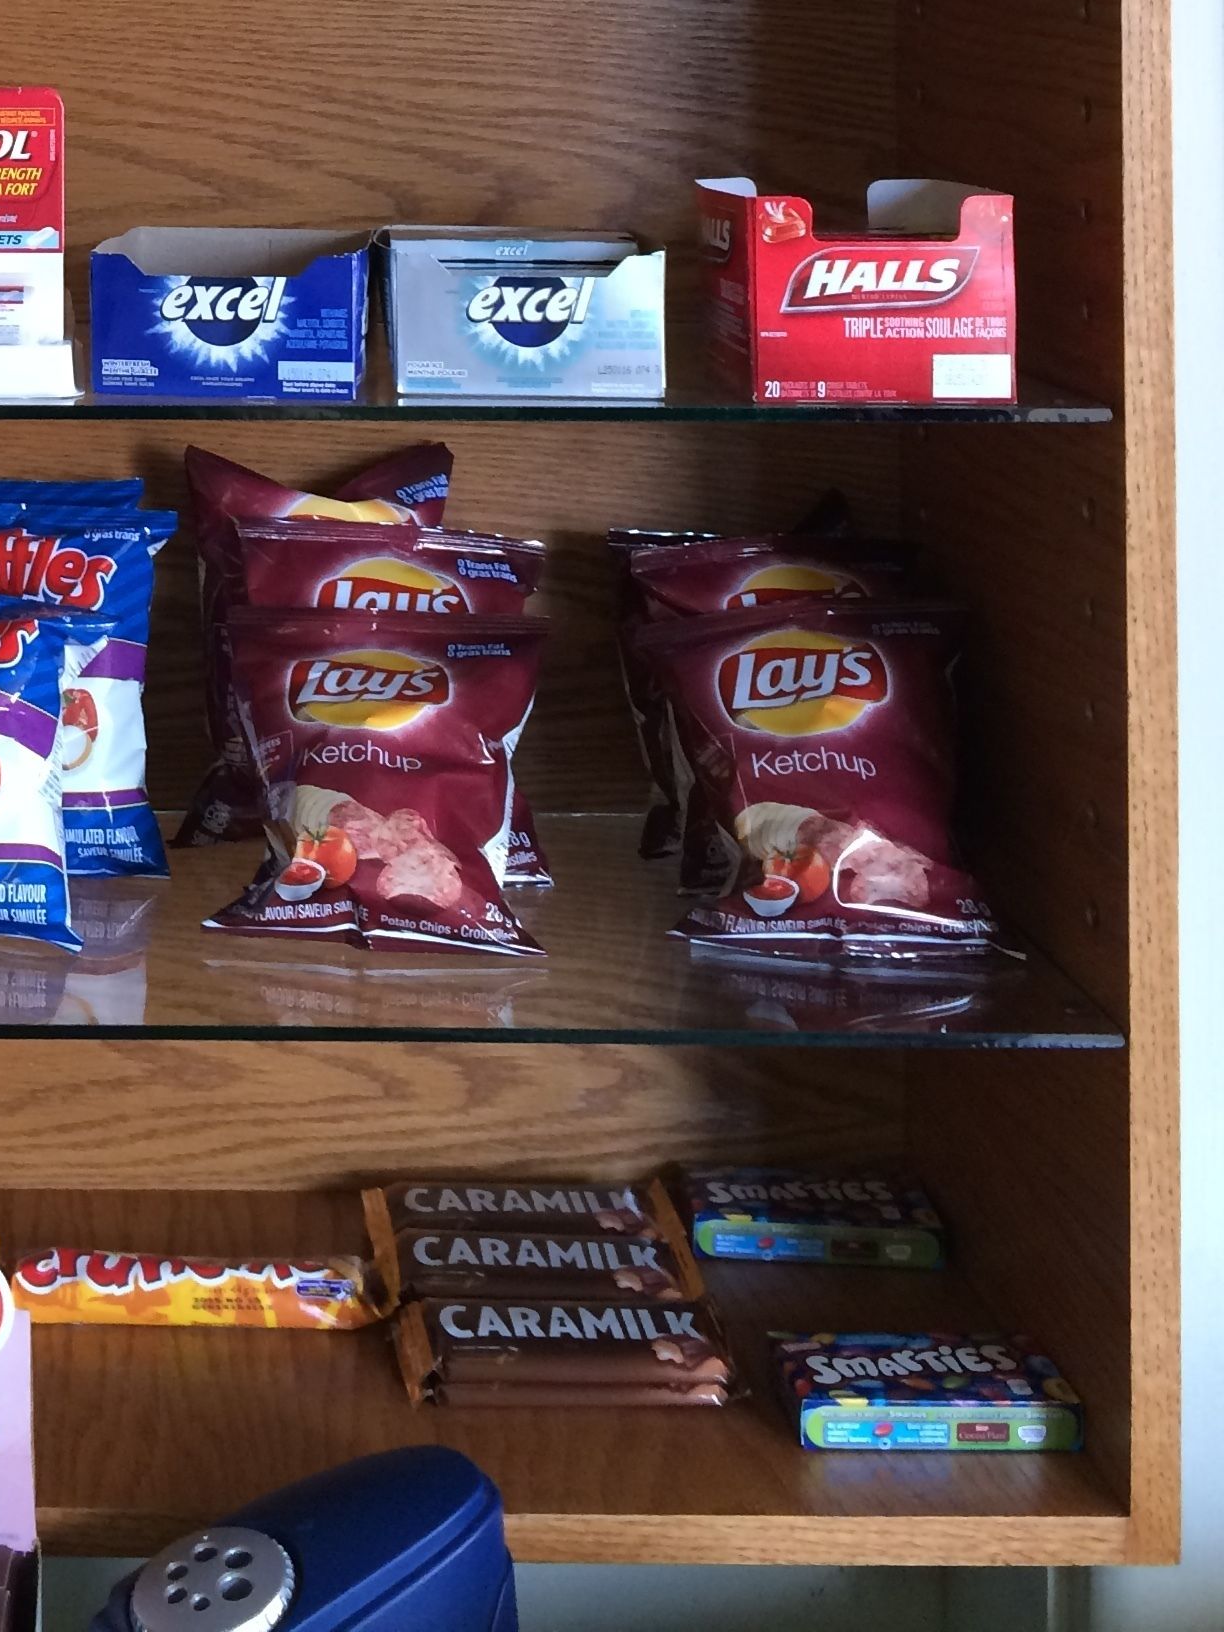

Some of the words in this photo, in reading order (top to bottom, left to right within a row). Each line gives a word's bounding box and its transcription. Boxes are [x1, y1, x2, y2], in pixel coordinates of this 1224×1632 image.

[5, 183, 38, 196] FORT
[495, 244, 528, 256] excel
[804, 258, 960, 299] HALLS
[161, 276, 286, 322] excel
[468, 277, 596, 323] excel
[843, 317, 884, 338] TRIPLE
[885, 317, 924, 327] SOOTHING
[925, 317, 974, 338] SOULAGE
[885, 328, 925, 338] ACTION
[764, 381, 780, 397] 20
[817, 381, 826, 397] 9
[457, 559, 464, 568] 0
[467, 559, 493, 570] Trans
[495, 563, 510, 572] Fat
[458, 567, 466, 575] 0
[468, 569, 490, 578] gras
[492, 571, 517, 583] trans
[296, 661, 438, 704] Lay's
[733, 645, 873, 709] Lay's
[301, 739, 422, 773] Ketchup
[751, 746, 876, 781] Ketchup
[8, 883, 46, 903] FLAVOUR
[12, 905, 47, 925] SIMULÉE
[380, 914, 417, 929] Potato
[420, 920, 451, 936] Chips
[404, 1187, 644, 1214] CARAMILK
[413, 1236, 659, 1271] CARAMILK
[439, 1304, 704, 1341] CARAMILK
